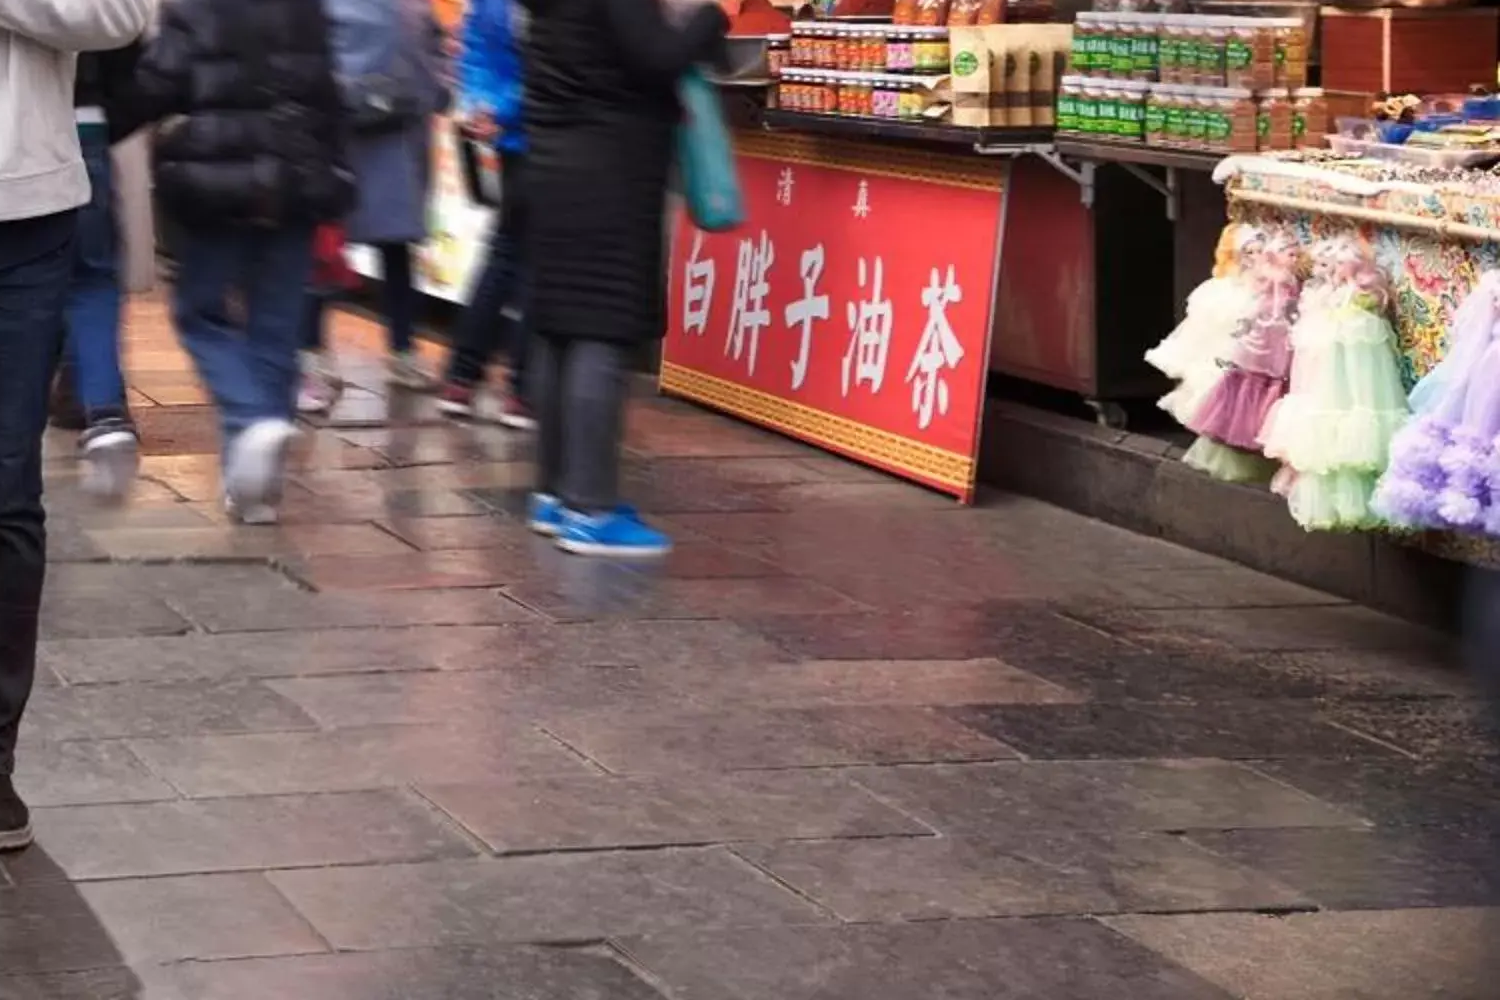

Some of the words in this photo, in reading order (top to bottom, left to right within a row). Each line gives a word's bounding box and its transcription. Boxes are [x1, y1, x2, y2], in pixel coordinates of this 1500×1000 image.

[776, 167, 872, 218] 清真
[684, 229, 966, 430] 白胖子油茶
